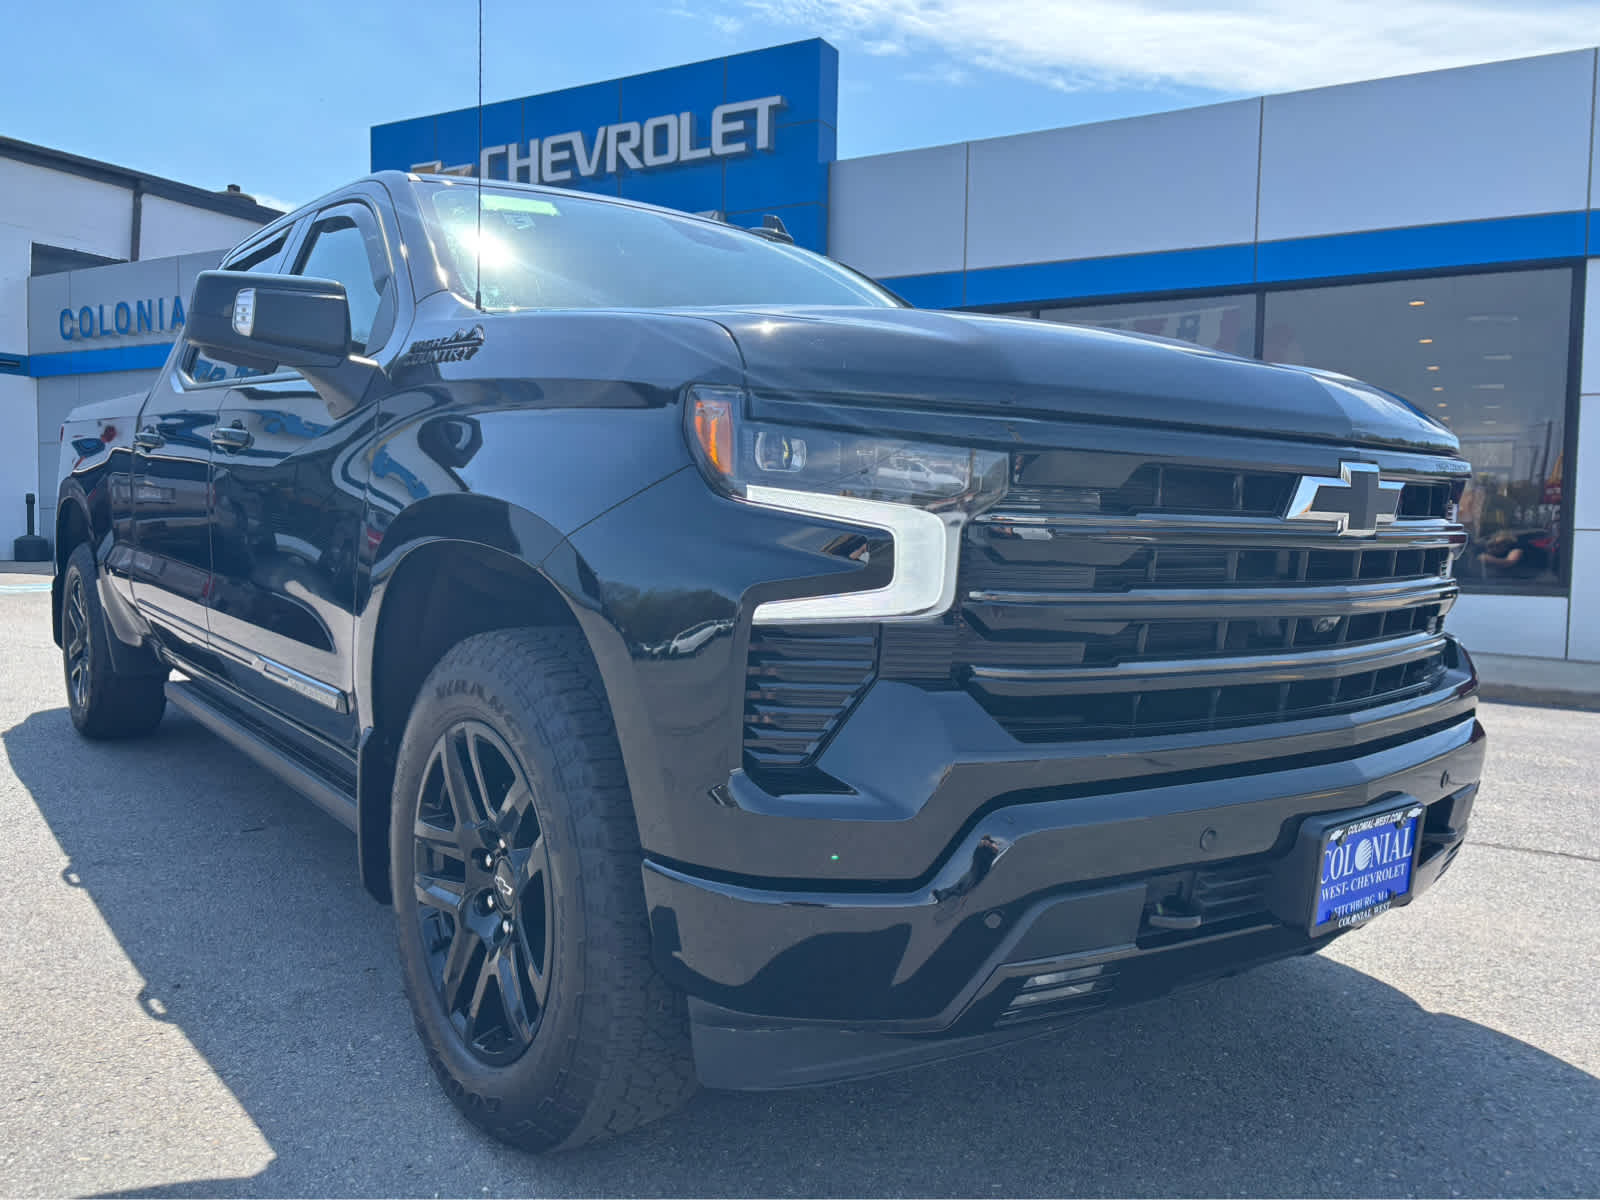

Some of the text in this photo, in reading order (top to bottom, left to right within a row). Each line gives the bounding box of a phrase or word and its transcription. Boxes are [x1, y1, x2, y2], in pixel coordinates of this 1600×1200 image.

[480, 95, 784, 184] CHEVROLET
[59, 296, 186, 340] COLONIA
[1320, 827, 1413, 885] COLONIAL
